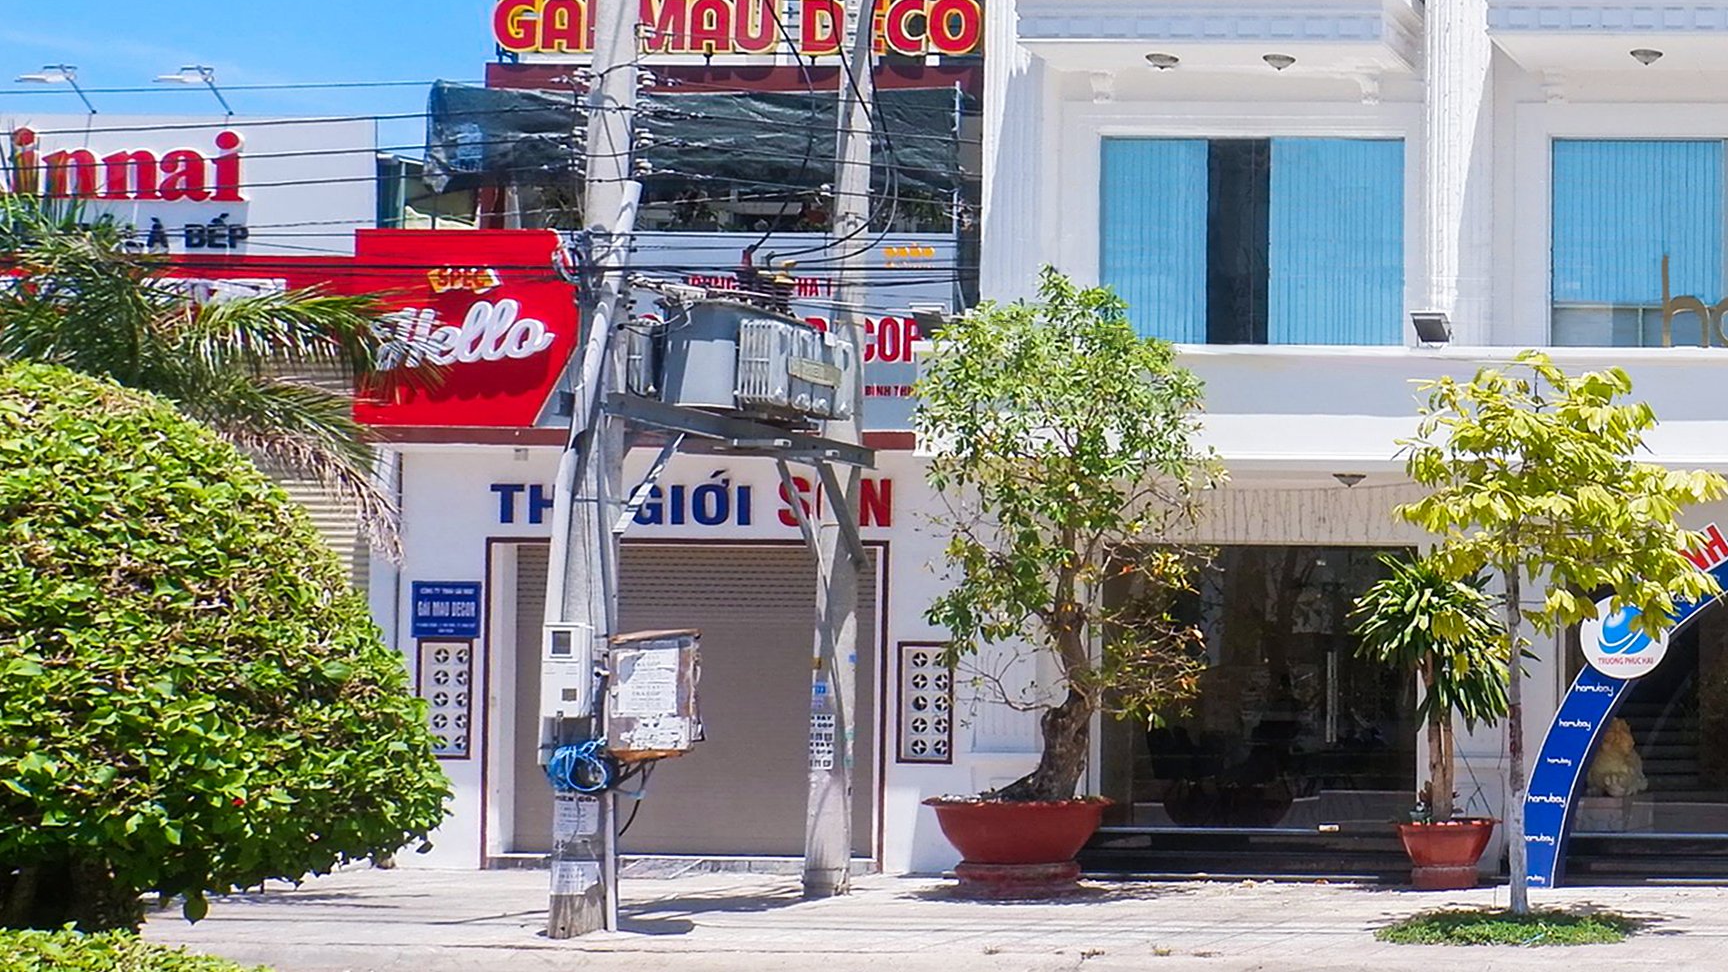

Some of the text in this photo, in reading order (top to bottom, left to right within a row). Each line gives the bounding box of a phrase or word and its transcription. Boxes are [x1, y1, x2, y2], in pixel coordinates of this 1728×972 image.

[185, 213, 248, 248] BẾP
[371, 298, 556, 371] Hello
[490, 470, 892, 527] TH GIỚI SN
[1575, 682, 1613, 697] hamubay
[1558, 717, 1591, 731] hamubay
[1527, 792, 1566, 808] hamubay
